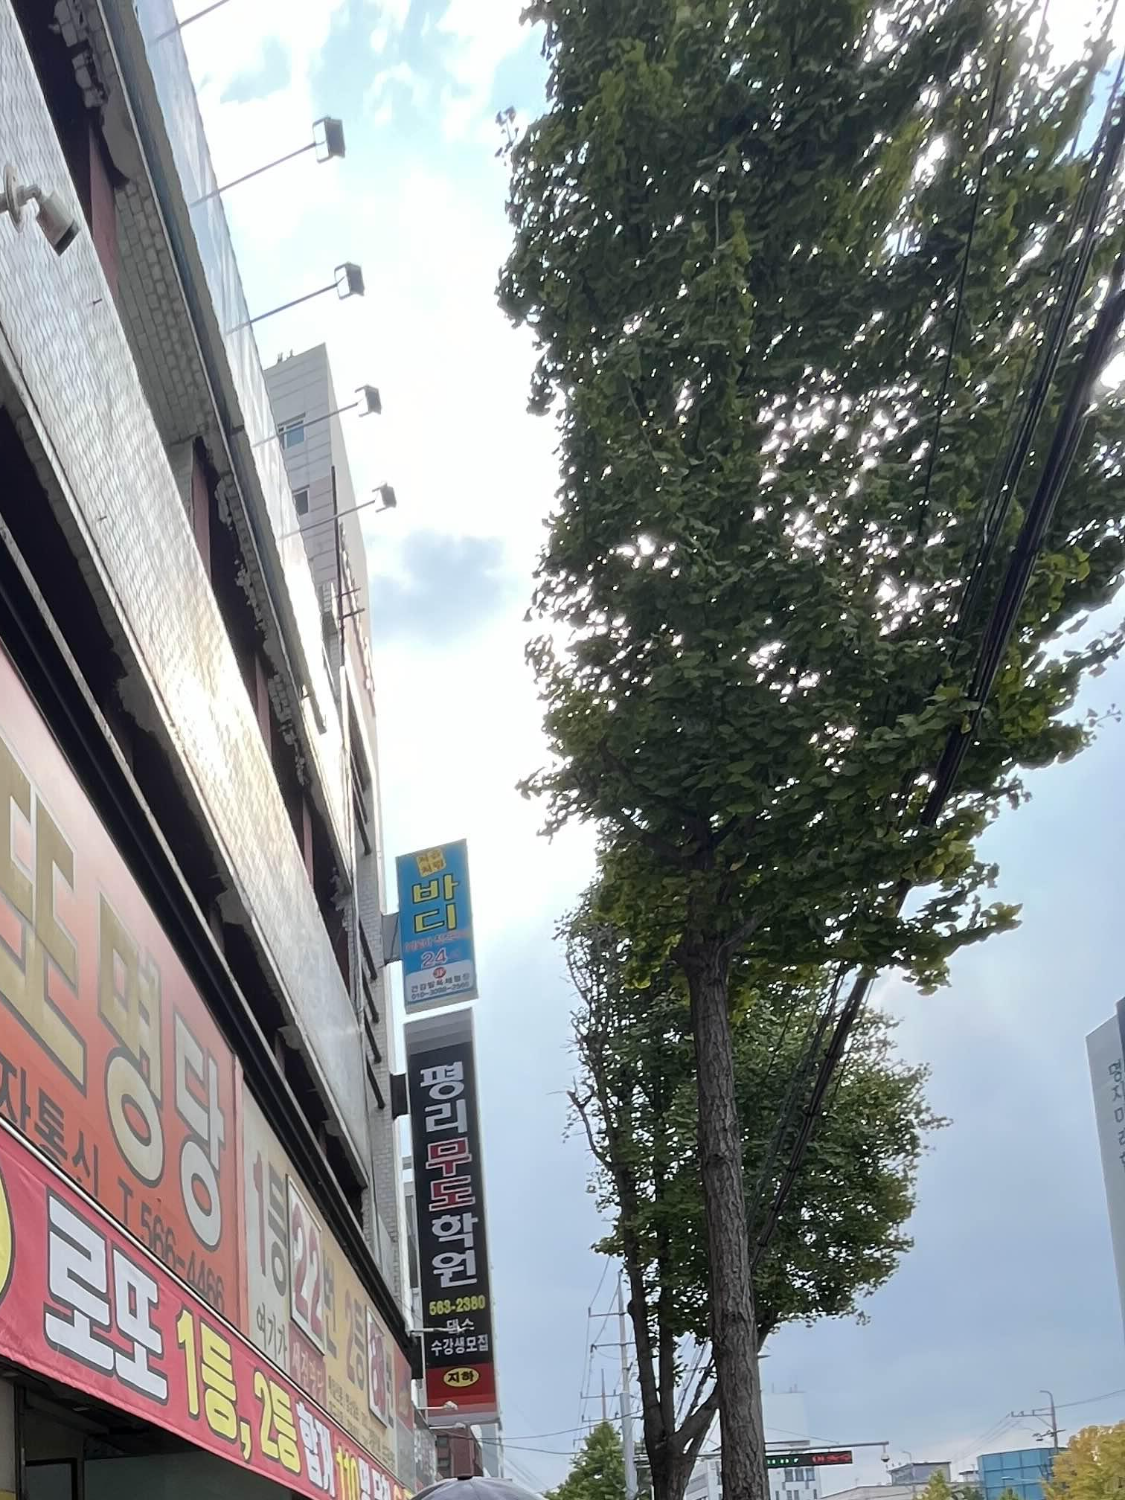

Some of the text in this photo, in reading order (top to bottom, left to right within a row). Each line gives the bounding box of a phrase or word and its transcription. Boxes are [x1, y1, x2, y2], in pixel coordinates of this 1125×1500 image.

[420, 1061, 478, 1289] 평리무도학원
[44, 1193, 168, 1400] 로또
[431, 1334, 489, 1356] 수강생모집
[447, 1370, 475, 1383] 지하
